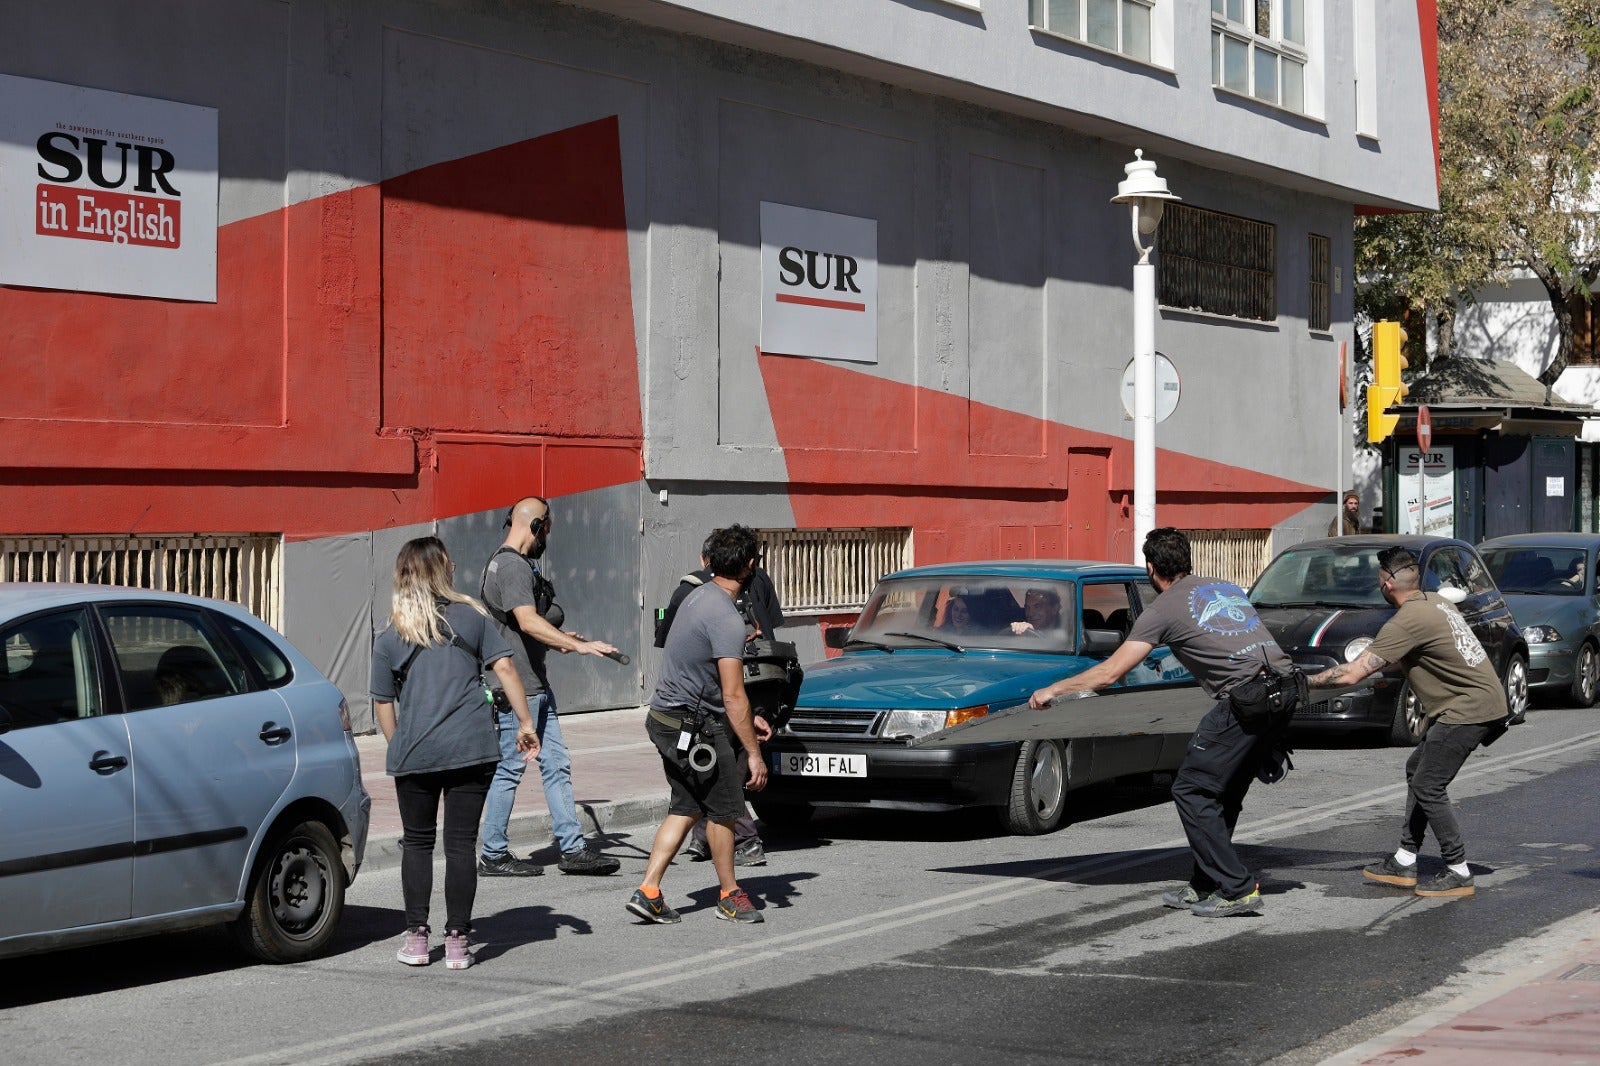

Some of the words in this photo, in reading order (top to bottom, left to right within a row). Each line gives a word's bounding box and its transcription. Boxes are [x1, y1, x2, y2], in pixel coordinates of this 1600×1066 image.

[56, 122, 66, 130] the
[69, 124, 103, 135] newspaper
[105, 128, 115, 137] for
[117, 131, 145, 141] southern
[147, 136, 165, 145] spain
[36, 132, 181, 196] SUR
[40, 191, 69, 231] in
[77, 195, 175, 244] English
[778, 246, 862, 293] SUR
[1408, 453, 1445, 464] SUR
[789, 756, 820, 772] 9131
[828, 757, 858, 774] FAL
